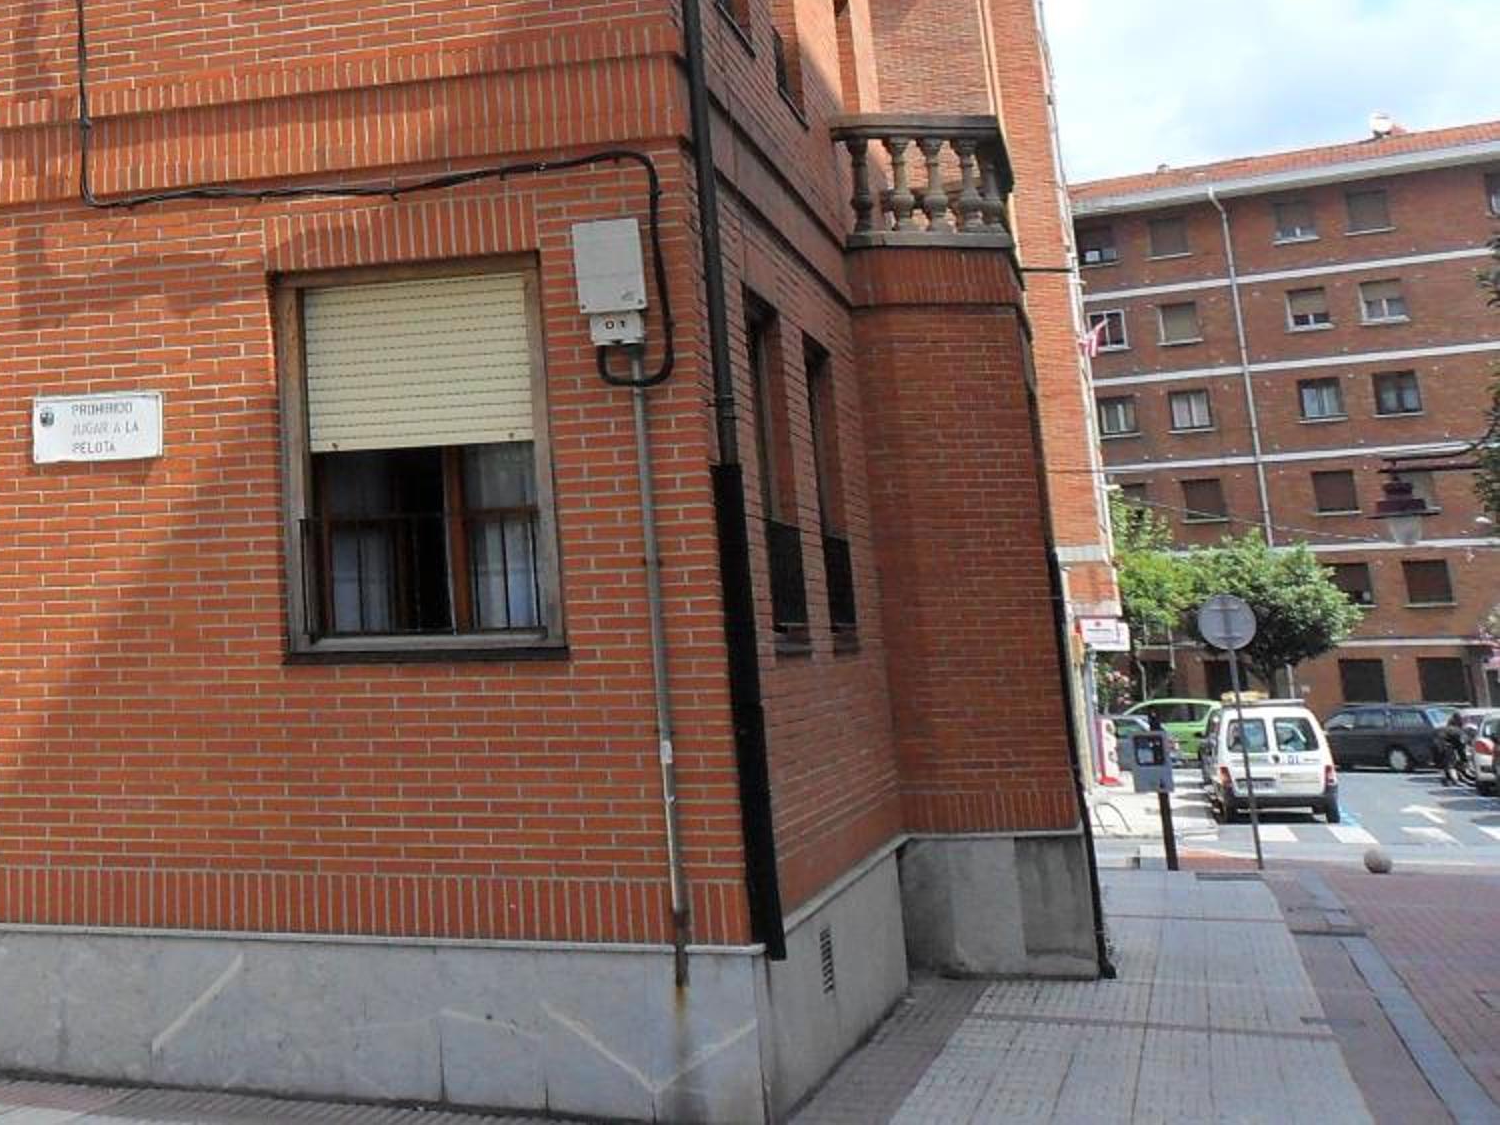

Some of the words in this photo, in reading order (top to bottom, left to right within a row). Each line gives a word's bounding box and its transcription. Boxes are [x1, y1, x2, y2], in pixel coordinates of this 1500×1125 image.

[71, 402, 133, 415] PROHIBIDO
[125, 420, 139, 434] LA
[71, 441, 116, 453] PELOTA
